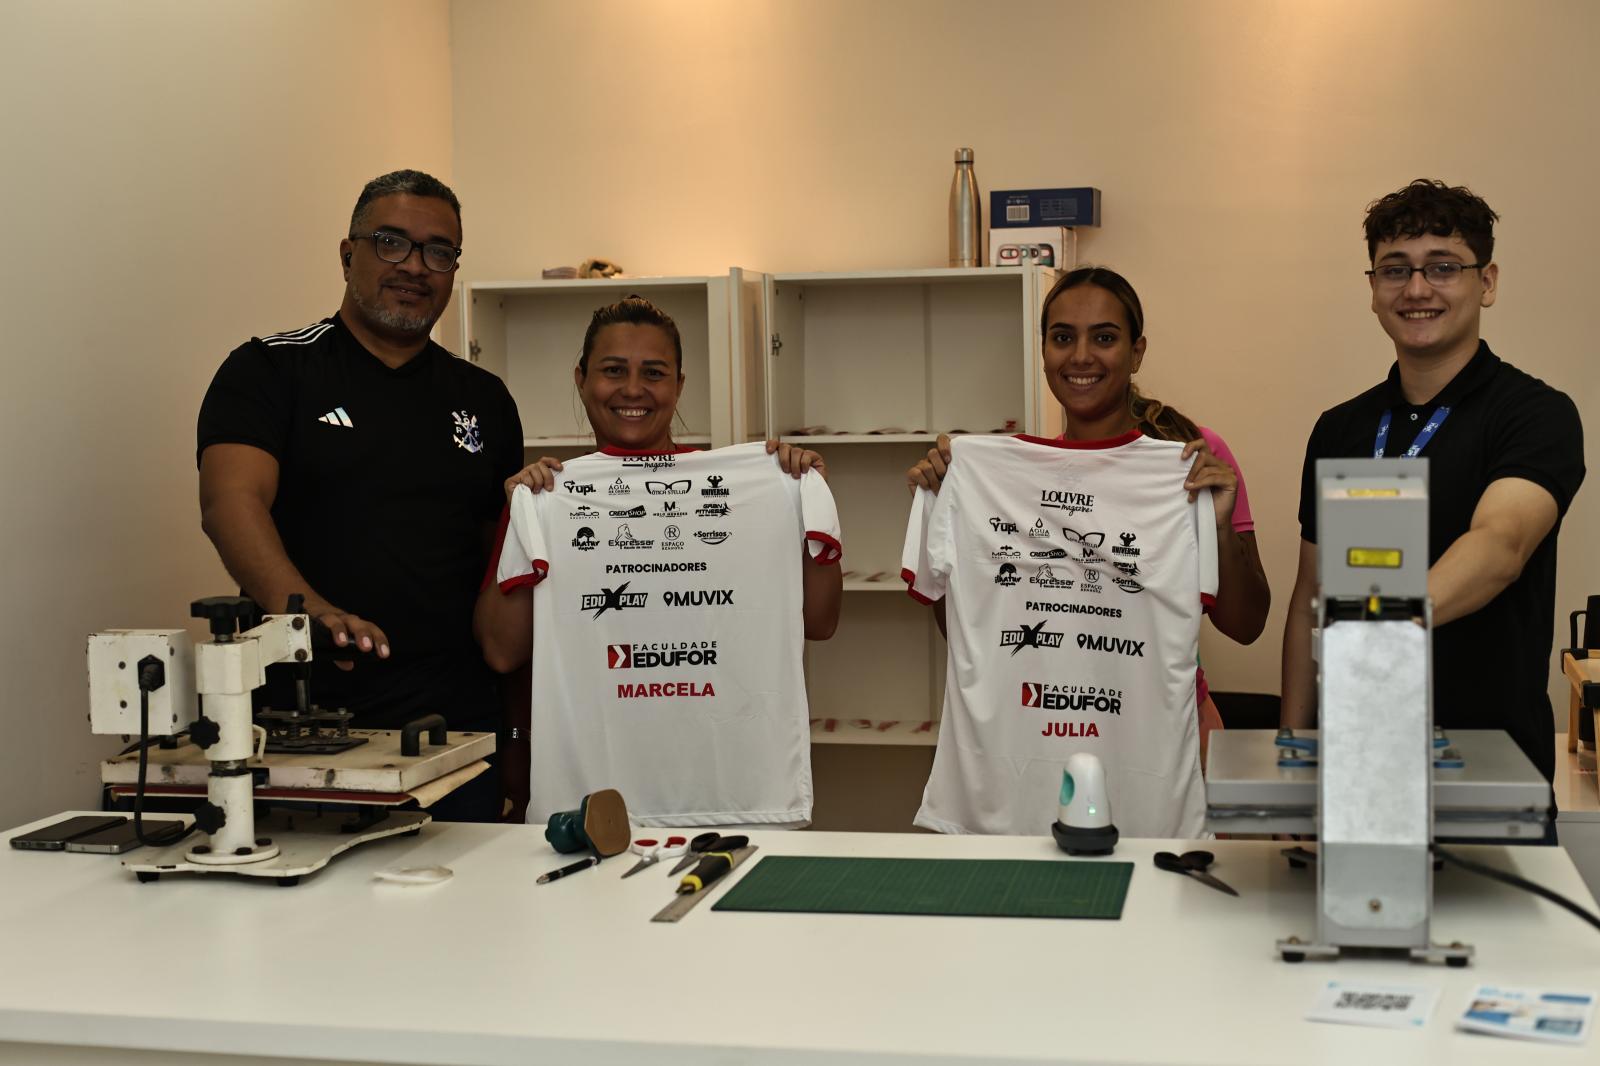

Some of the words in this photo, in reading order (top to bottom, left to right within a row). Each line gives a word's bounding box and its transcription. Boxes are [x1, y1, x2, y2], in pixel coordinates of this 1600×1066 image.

[1041, 490, 1094, 506] LOUVRE
[605, 562, 707, 574] PATROCINADORES
[674, 589, 734, 606] MUVIX
[1025, 601, 1123, 618] PATROCINADORES
[633, 641, 717, 651] FACULDADE
[1087, 634, 1145, 657] MUVIX
[633, 650, 718, 668] EDUFOR
[617, 682, 716, 699] MARCELA
[1043, 684, 1123, 699] FACULDADE
[1043, 693, 1122, 716] EDUFOR
[1042, 722, 1100, 737] JULIA
